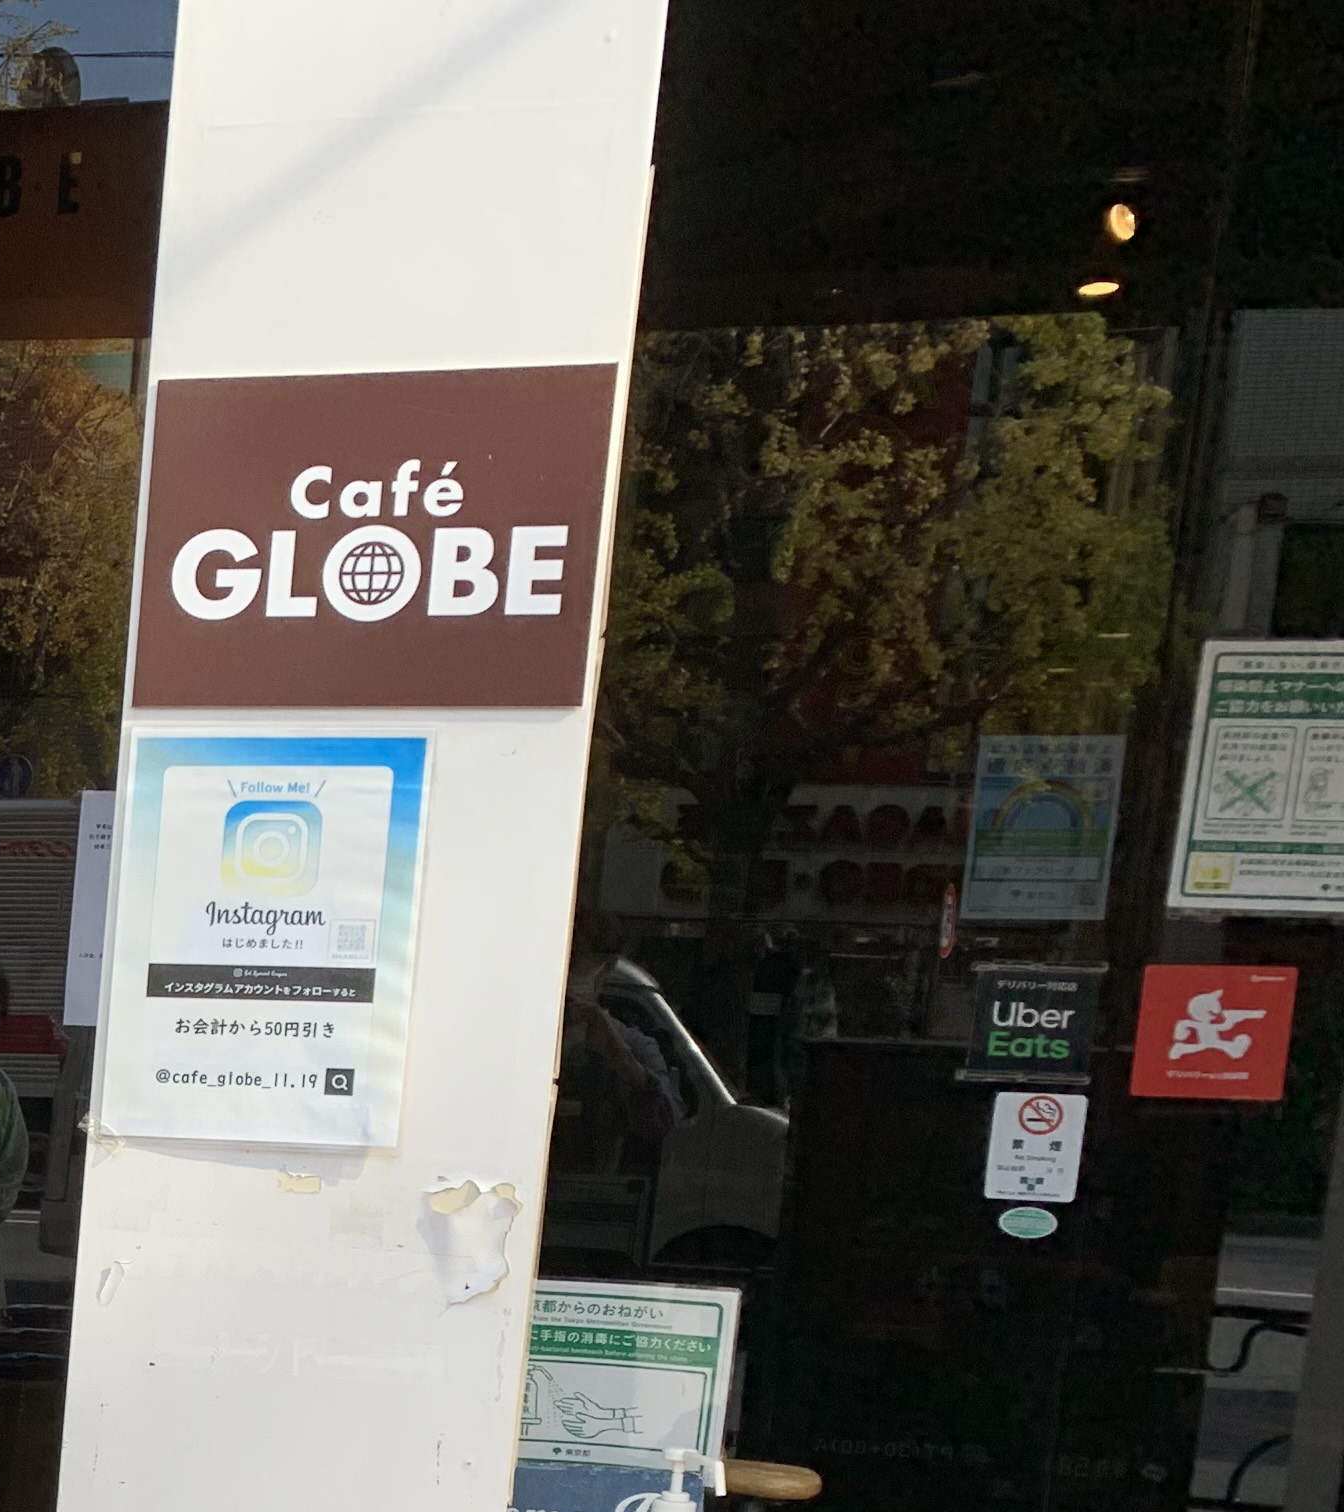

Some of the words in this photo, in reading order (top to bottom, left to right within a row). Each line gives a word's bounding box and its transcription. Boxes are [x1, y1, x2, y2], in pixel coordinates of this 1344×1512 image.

[289, 458, 465, 520] Café
[170, 523, 570, 623] GLOBE
[240, 780, 283, 795] Follow
[285, 781, 311, 795] Me!
[205, 900, 327, 937] Instagram
[164, 981, 357, 998] インスタグラムアカウントをフォローすると
[174, 1018, 335, 1039] お会計から50円引き
[992, 1000, 1076, 1030] Uber
[987, 1031, 1070, 1060] Eats
